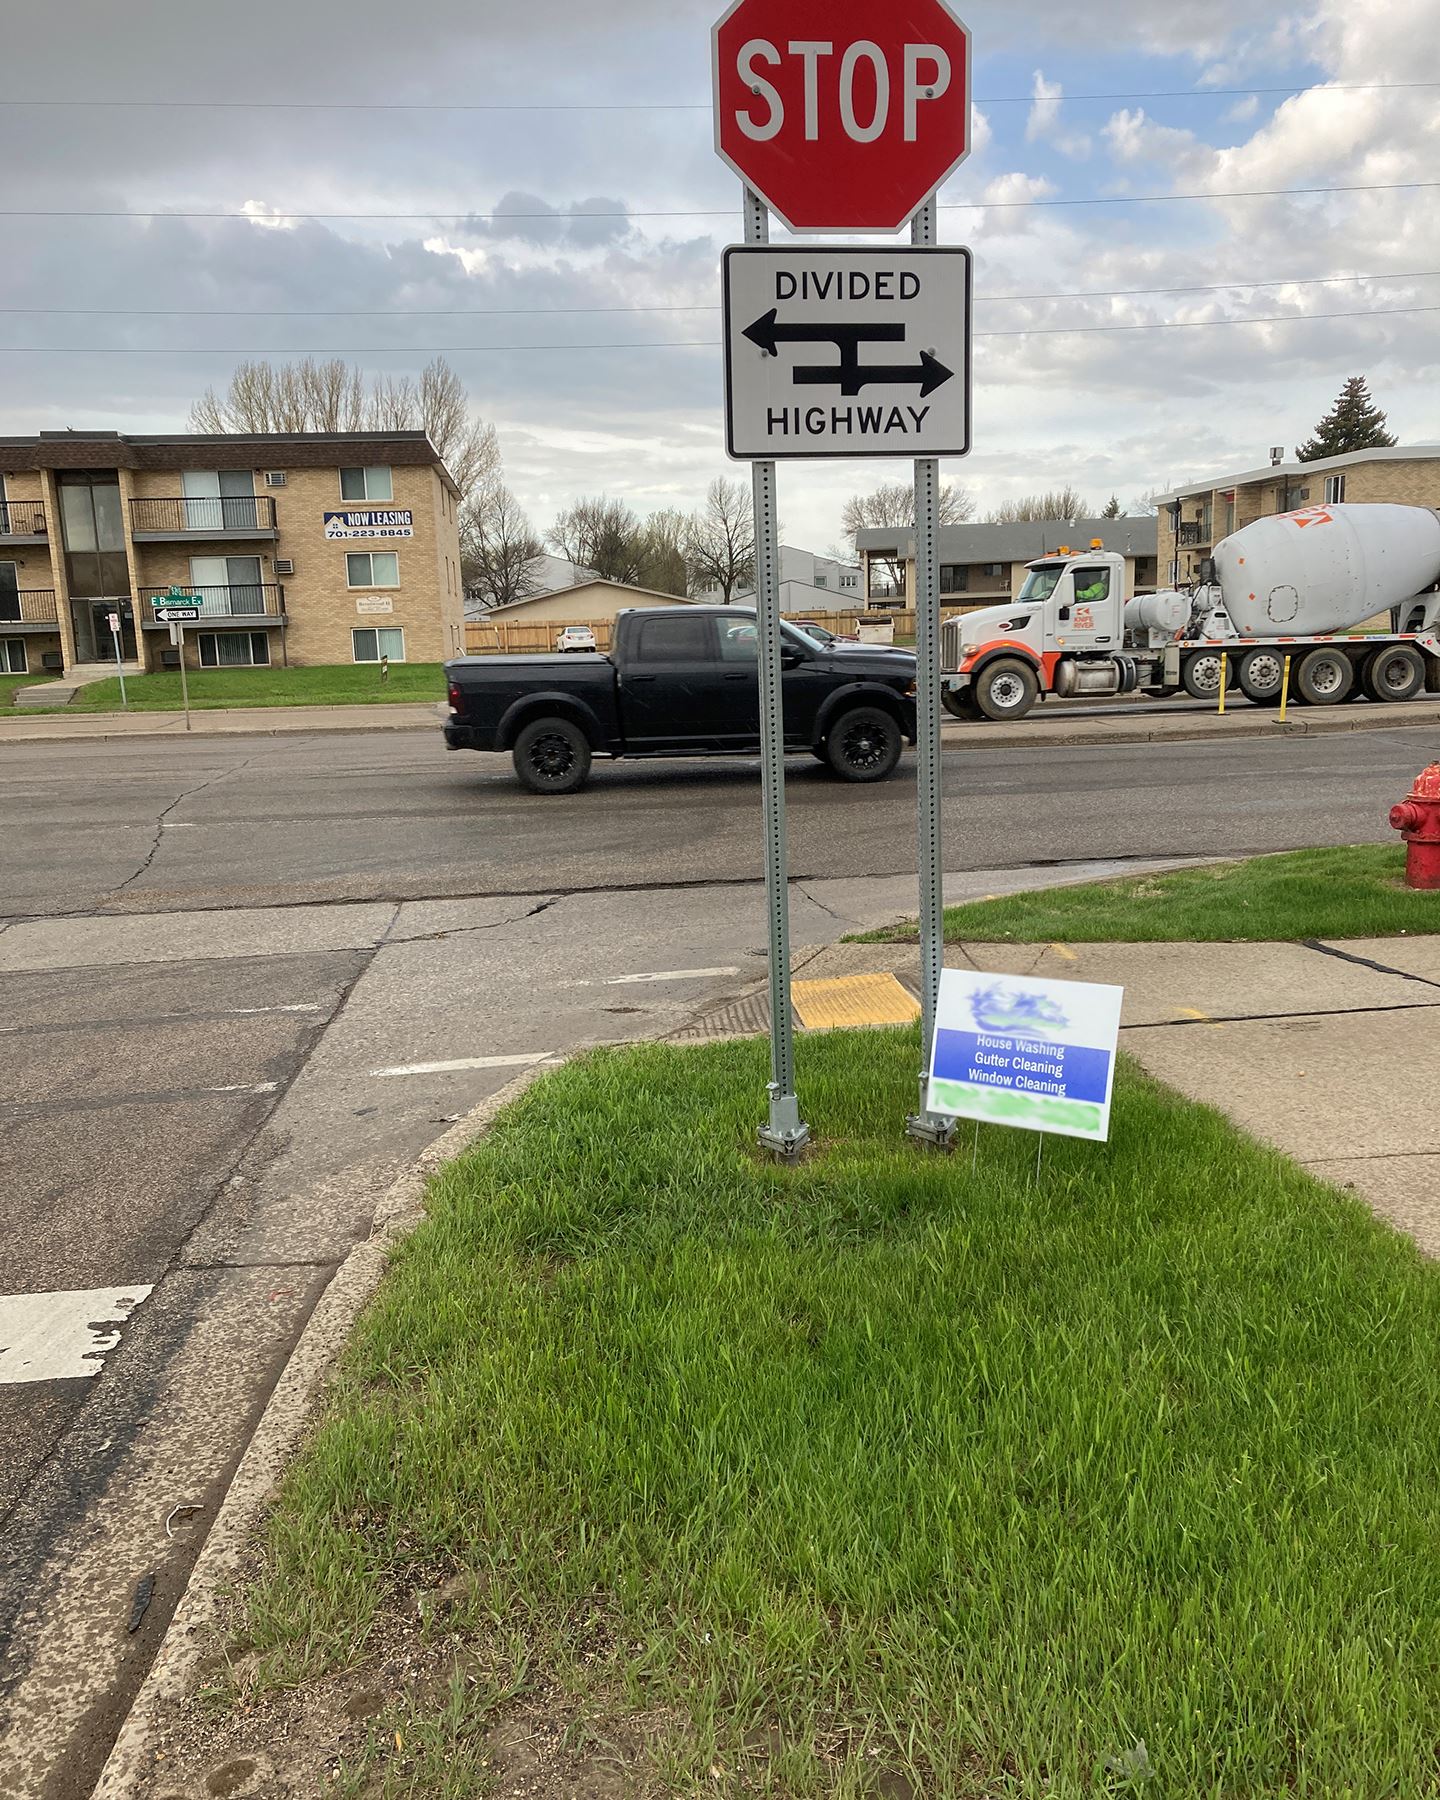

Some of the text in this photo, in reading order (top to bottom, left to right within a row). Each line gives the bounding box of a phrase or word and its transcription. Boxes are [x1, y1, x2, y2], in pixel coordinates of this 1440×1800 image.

[735, 39, 952, 143] STOP
[775, 271, 921, 300] DIVIDED
[767, 406, 931, 435] HIGHWAY
[347, 511, 411, 526] NOW LEASING
[327, 529, 411, 538] 701-223-8845
[151, 597, 157, 605] E
[160, 597, 190, 605] Bismarck
[976, 1034, 1065, 1060] House Washing
[975, 1051, 1064, 1078] Gutter Cleaning
[968, 1068, 1067, 1097] Window Cleaning
